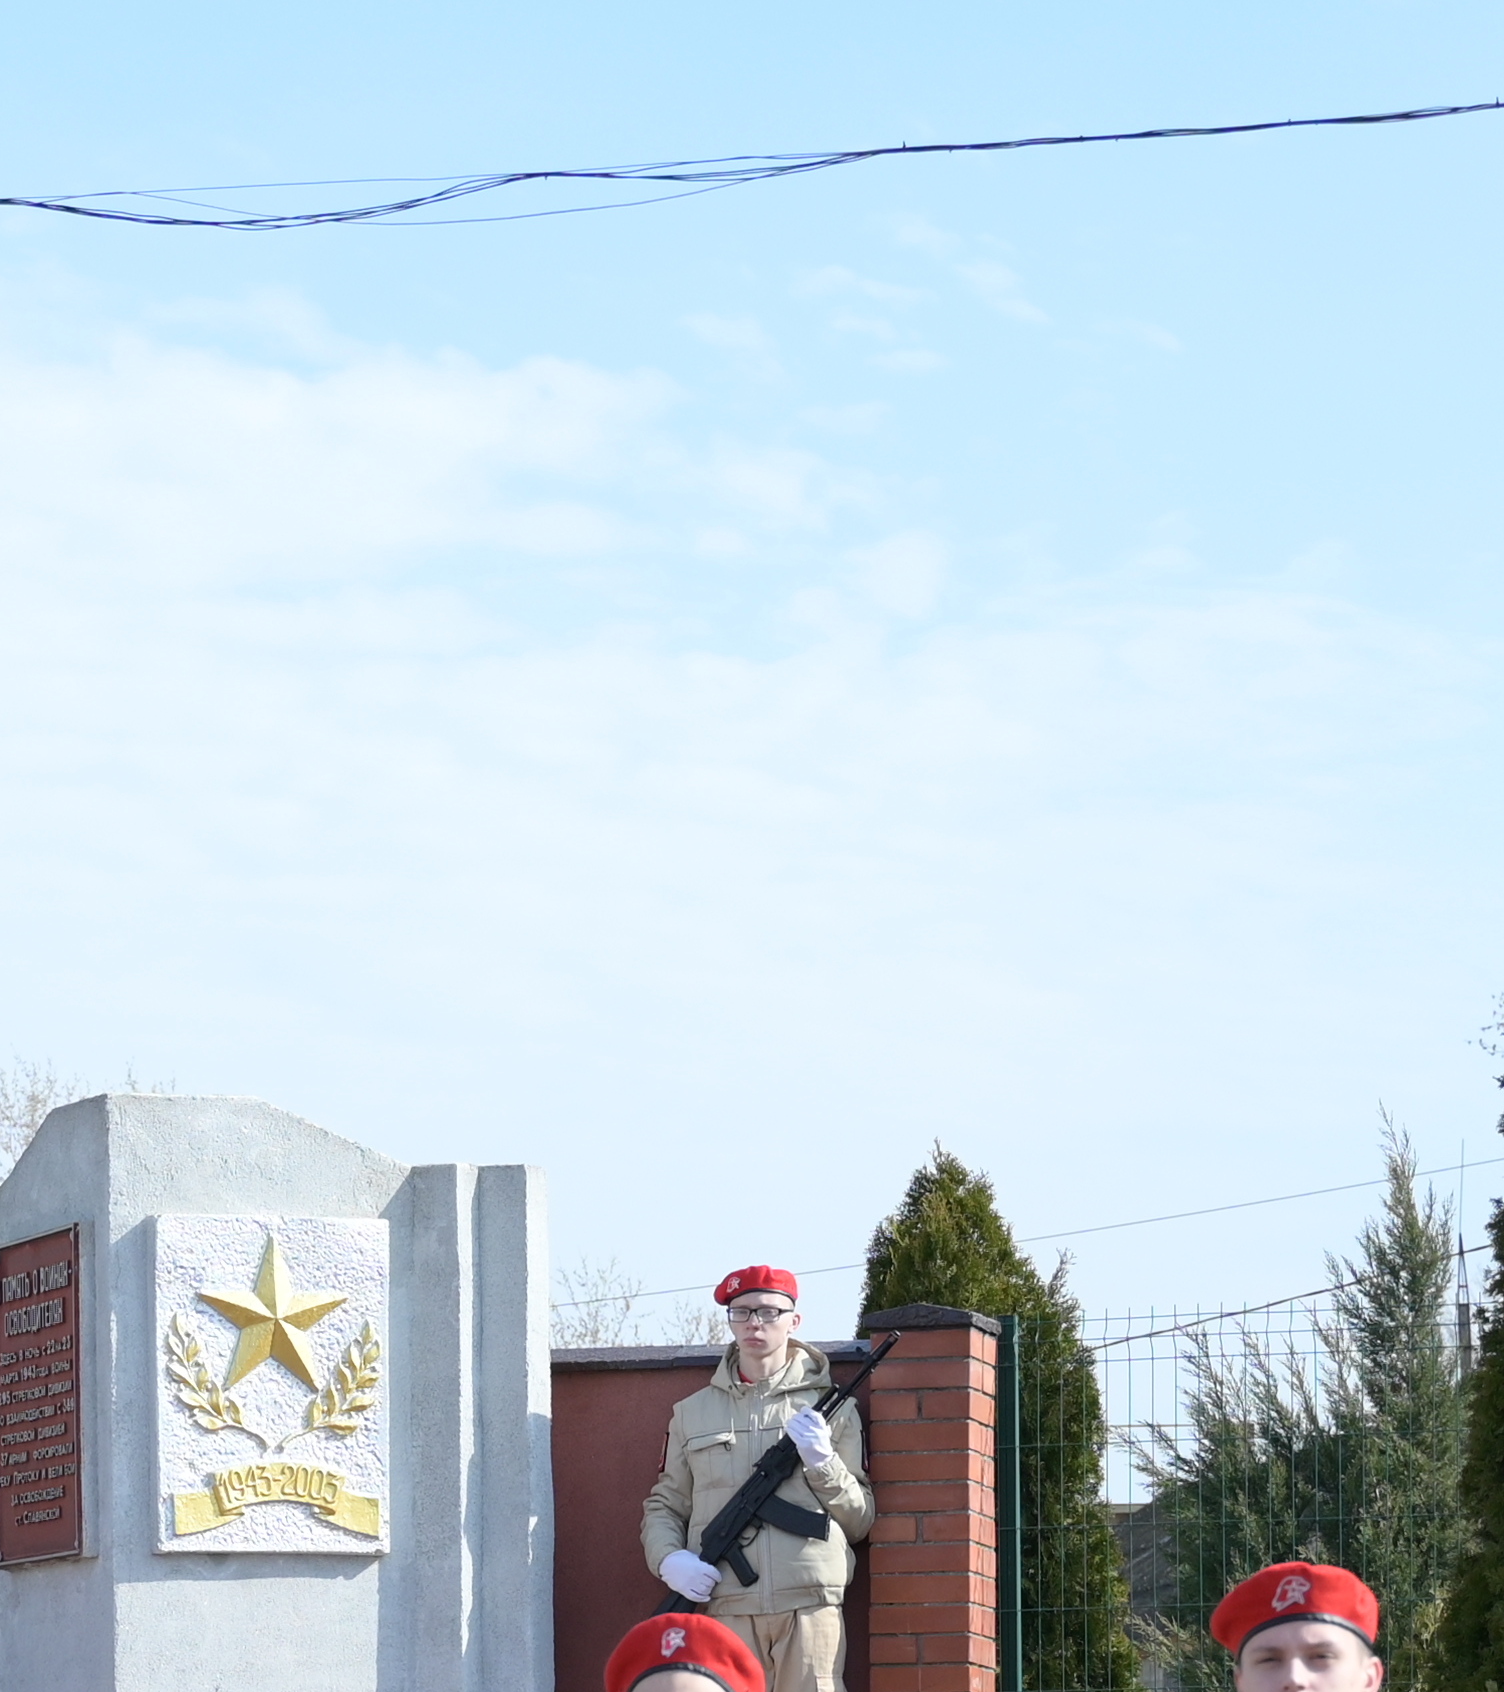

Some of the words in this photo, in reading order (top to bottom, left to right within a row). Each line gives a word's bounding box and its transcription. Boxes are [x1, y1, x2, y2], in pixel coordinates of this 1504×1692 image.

[2, 1272, 29, 1302] ПАМЯТЬ
[33, 1269, 38, 1295] О
[218, 1465, 339, 1504] 1943-2003
